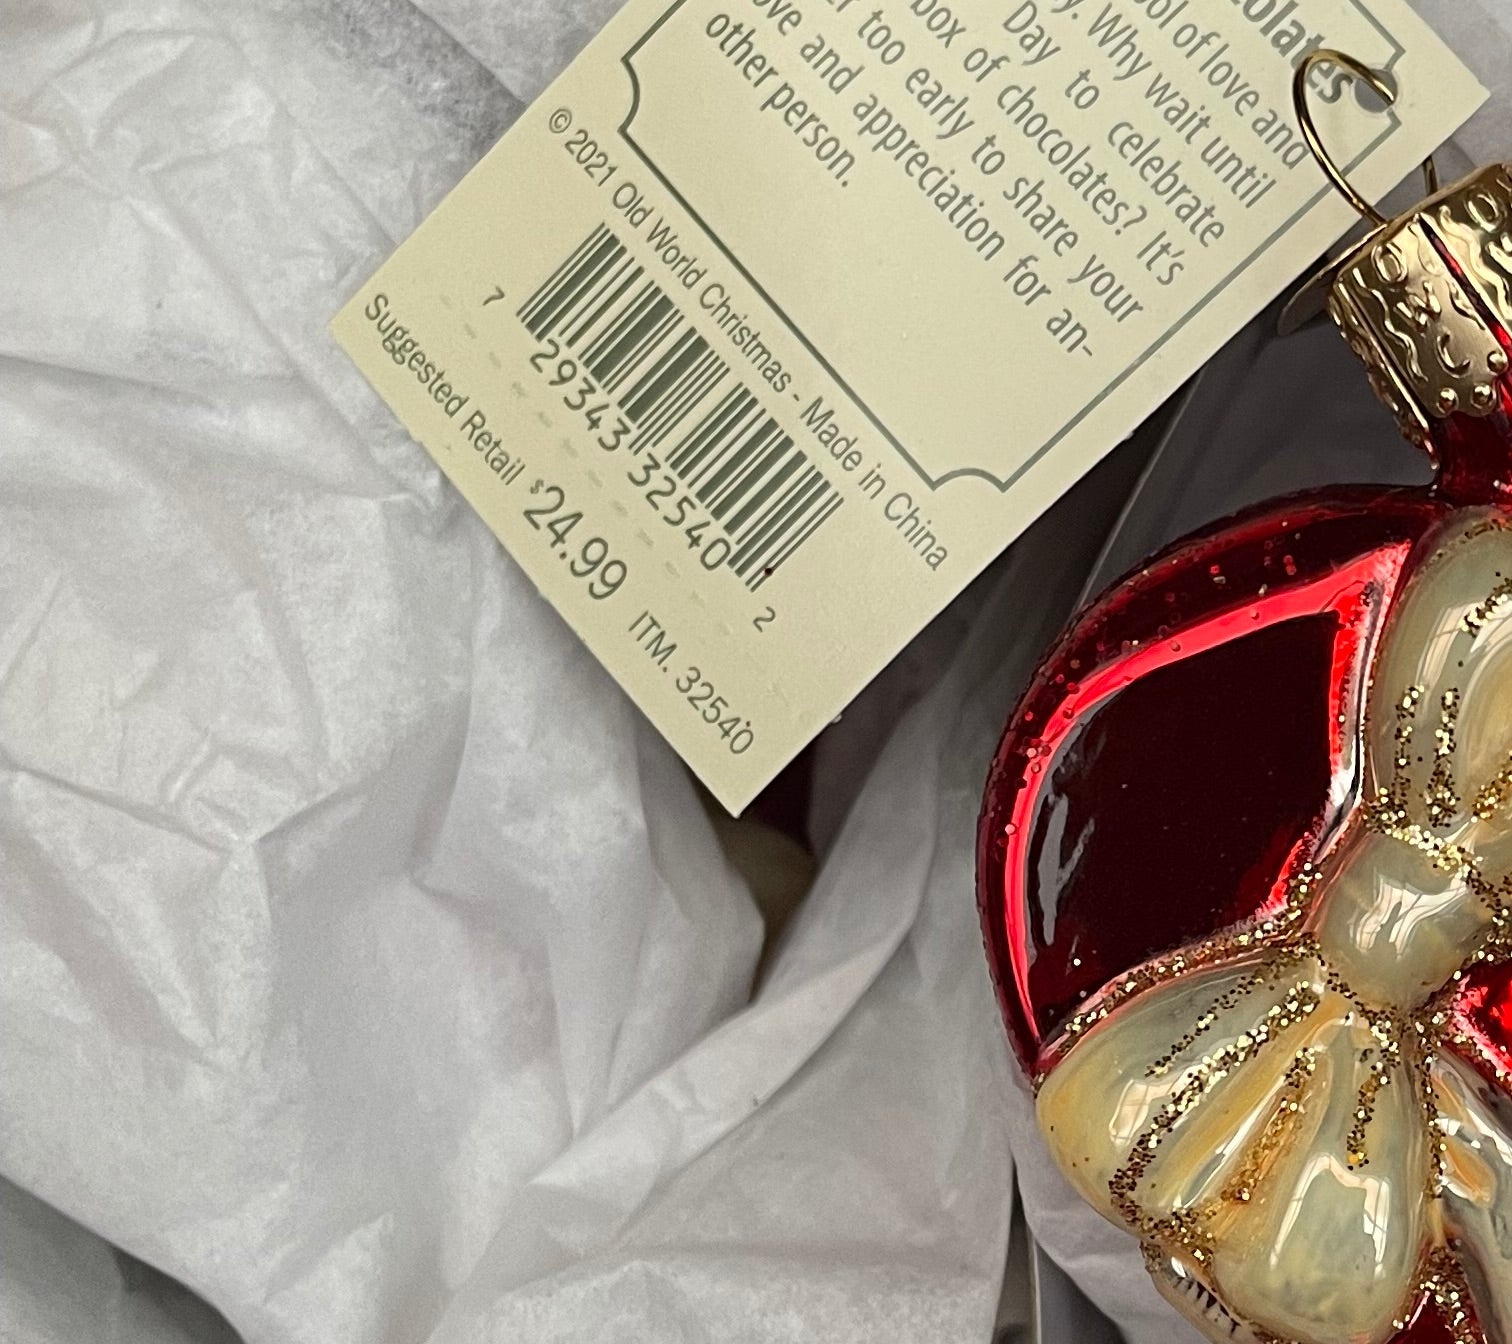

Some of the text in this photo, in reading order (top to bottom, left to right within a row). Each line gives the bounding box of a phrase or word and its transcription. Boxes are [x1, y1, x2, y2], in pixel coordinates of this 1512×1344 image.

[705, 13, 856, 188] other person.
[799, 33, 866, 95] and
[852, 93, 1005, 262] appreciation
[1002, 254, 1052, 307] for
[1045, 307, 1093, 357] an-
[857, 9, 906, 66] too
[904, 67, 976, 140] early
[970, 134, 1006, 176] to
[1002, 176, 1079, 258] share
[1066, 253, 1144, 323] your
[963, 47, 1012, 83] of
[996, 84, 1148, 236] chocolates?
[1136, 229, 1186, 286] It's
[1001, 0, 1062, 67] Day
[1064, 68, 1100, 110] to
[1107, 121, 1225, 248] celebrate
[1087, 1, 1153, 81] Why
[1144, 71, 1212, 146] wait
[1200, 135, 1278, 209] until
[1172, 22, 1222, 60] of
[1198, 42, 1260, 117] love
[1251, 109, 1311, 171] and
[482, 285, 777, 633] 7 29343 32540 2
[563, 128, 619, 188] 2021
[611, 181, 655, 230] Old
[645, 215, 709, 291] World
[699, 282, 792, 394] Christmas
[799, 395, 863, 472] Made
[857, 462, 887, 500] in
[883, 492, 948, 572] China
[364, 292, 755, 755] Suggested Retail $24.99 ITM. 32540
